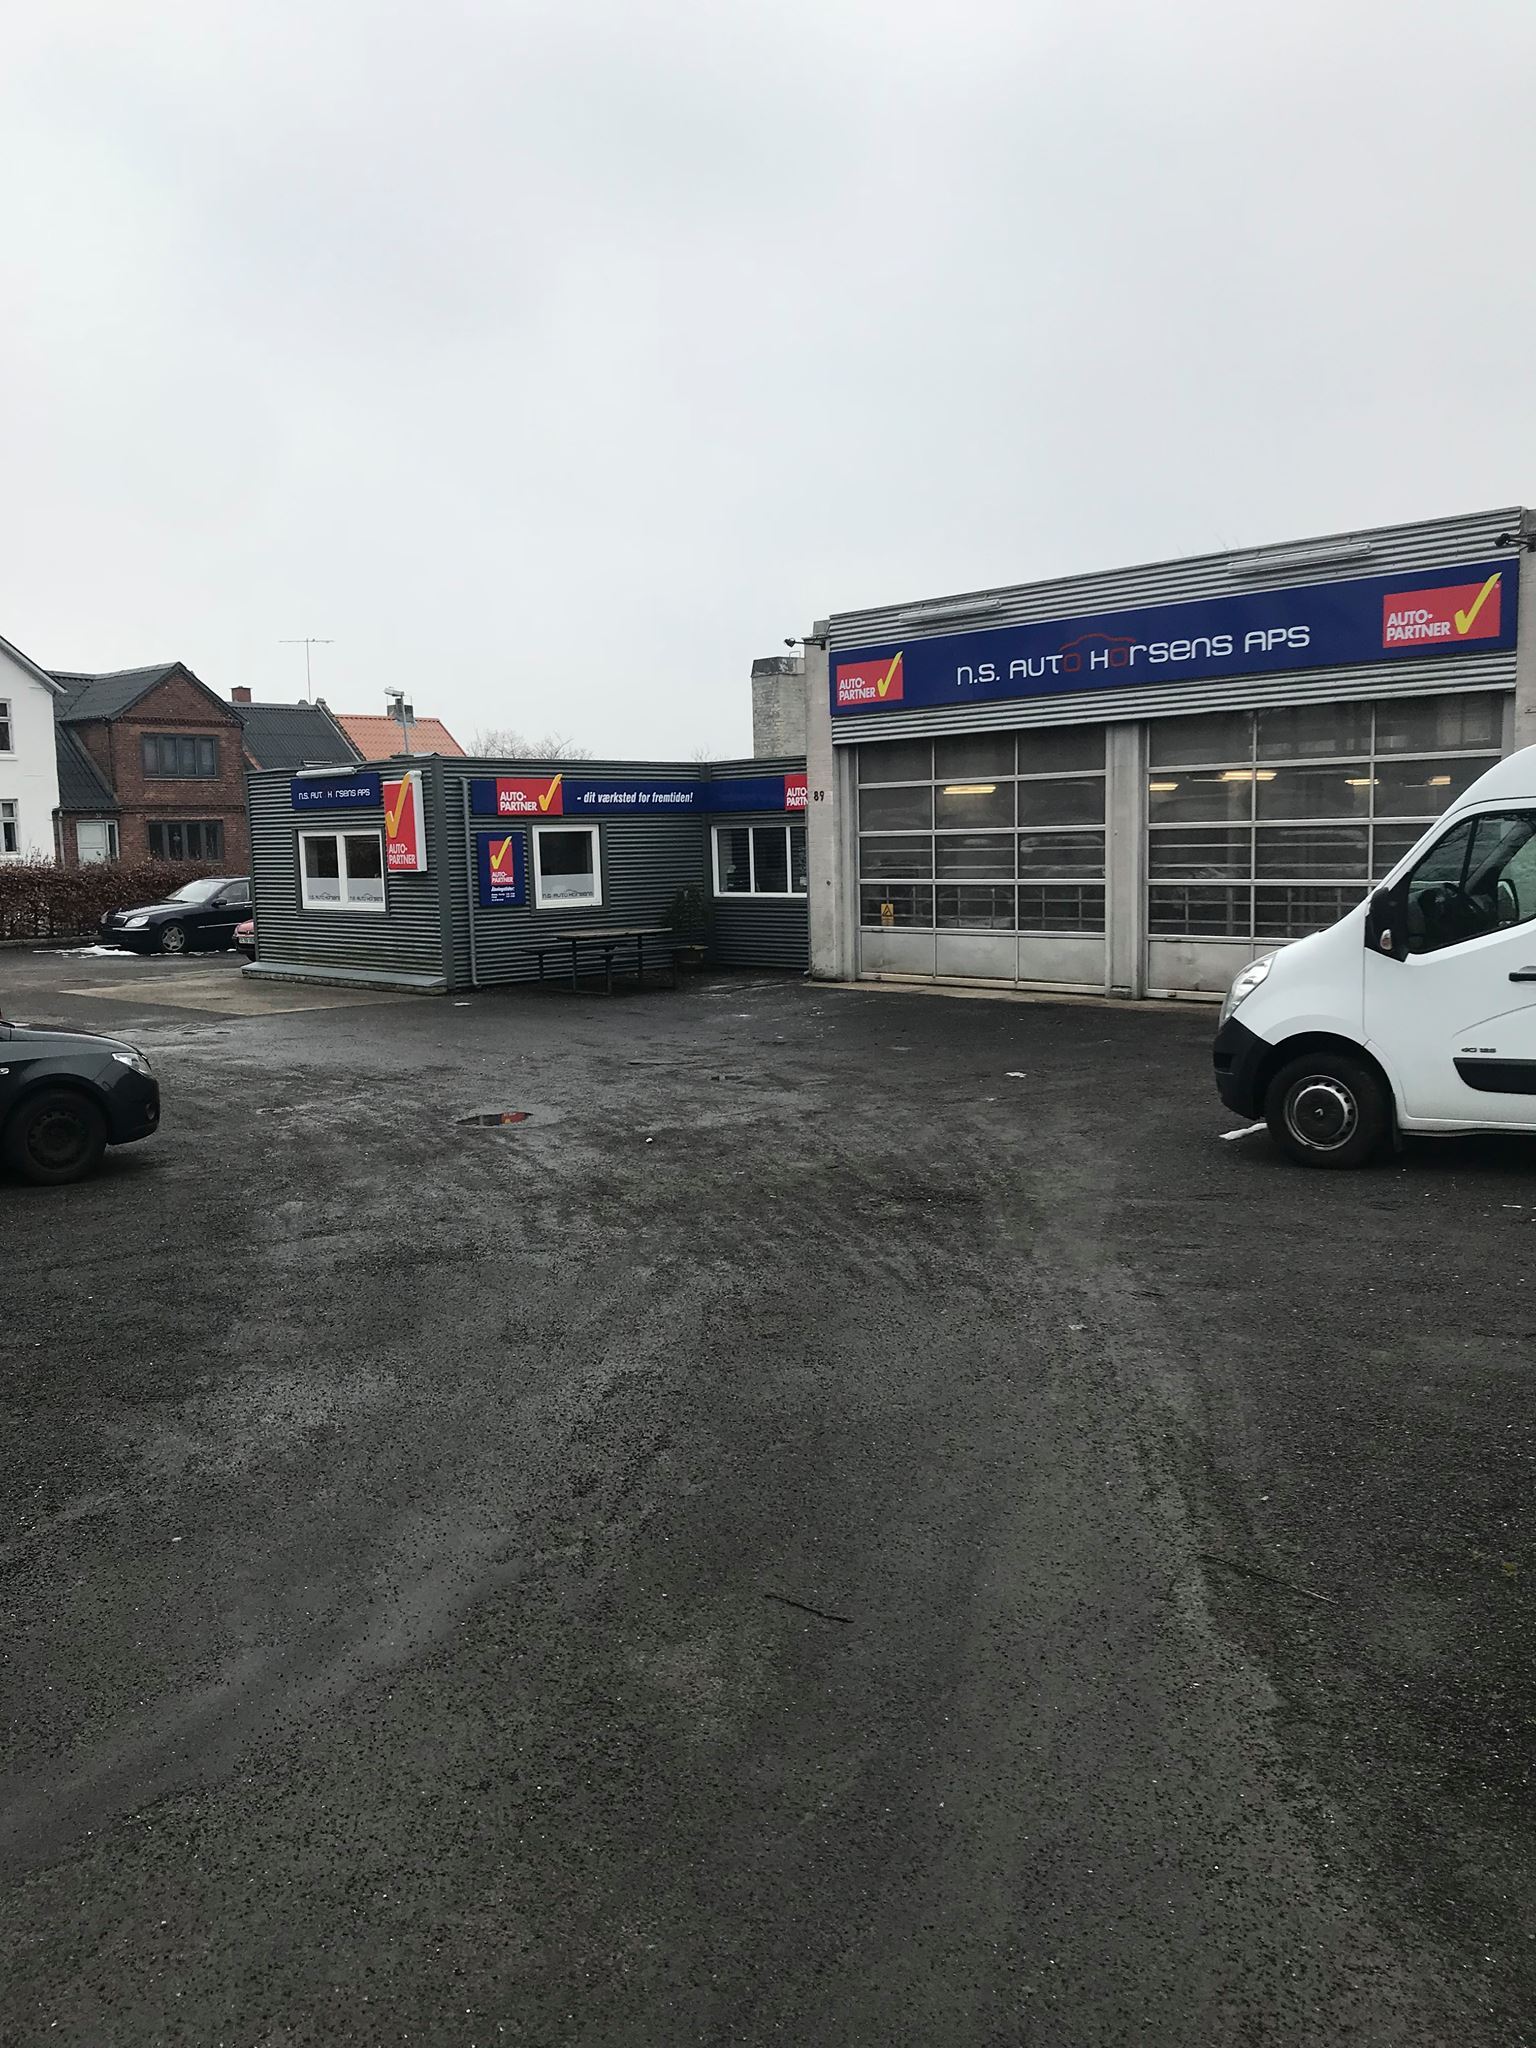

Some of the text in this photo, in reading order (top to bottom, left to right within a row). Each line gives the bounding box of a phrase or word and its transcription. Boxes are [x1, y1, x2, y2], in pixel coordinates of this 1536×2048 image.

[1386, 609, 1434, 627] AUTO-
[1386, 621, 1452, 641] PARTNER
[1009, 652, 1081, 680] AUTO
[1090, 633, 1233, 670] Horsens
[1244, 625, 1311, 653] APS
[839, 677, 866, 690] AUTO-
[839, 687, 876, 701] PARTNER
[357, 788, 371, 797] APS
[500, 791, 527, 801] AUTO-
[583, 791, 595, 803] dit
[597, 791, 637, 803] værksted
[638, 791, 651, 803] for
[652, 791, 694, 803] fremtiden!
[813, 790, 825, 801] 89
[500, 801, 537, 811] PARTNER
[786, 797, 808, 806] PARTN
[388, 843, 408, 855] AUTO-
[388, 854, 416, 865] PARTNER
